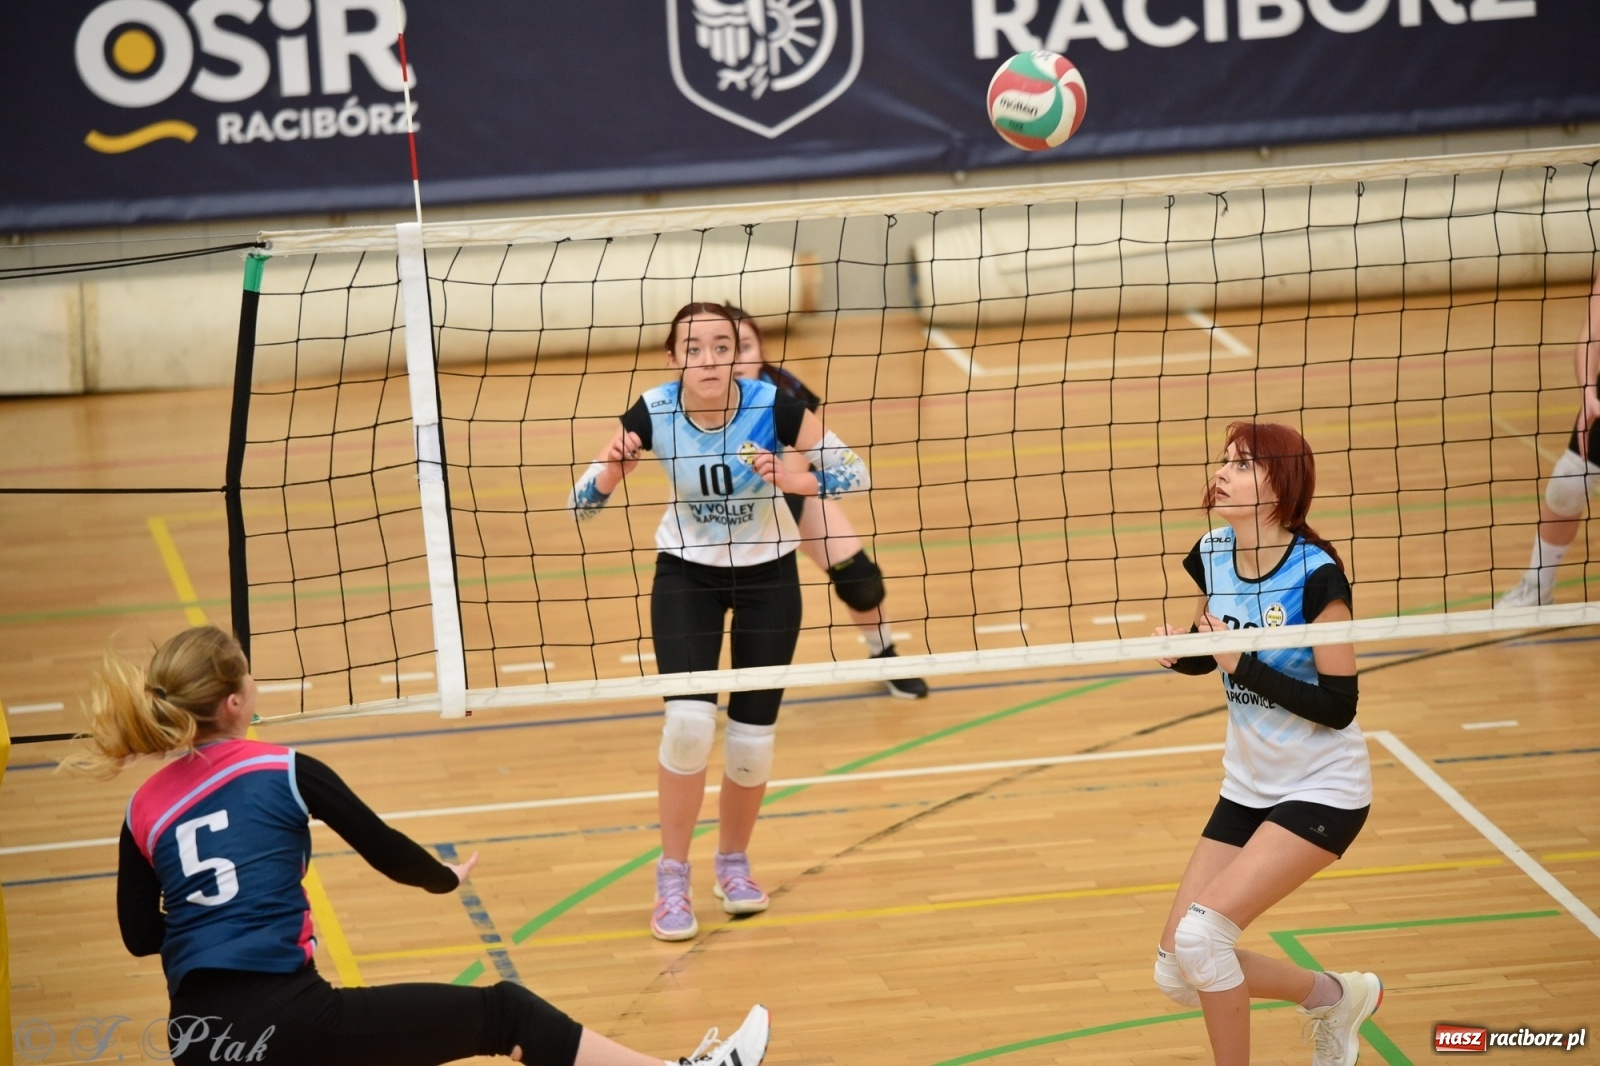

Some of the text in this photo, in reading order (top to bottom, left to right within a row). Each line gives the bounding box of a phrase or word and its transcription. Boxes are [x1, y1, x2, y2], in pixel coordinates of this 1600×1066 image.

[971, 0, 1537, 59] RACIB
[217, 97, 420, 145] RACIBÓRZ
[699, 463, 734, 496] 10
[705, 502, 755, 516] VOLLEY
[175, 809, 239, 906] 5
